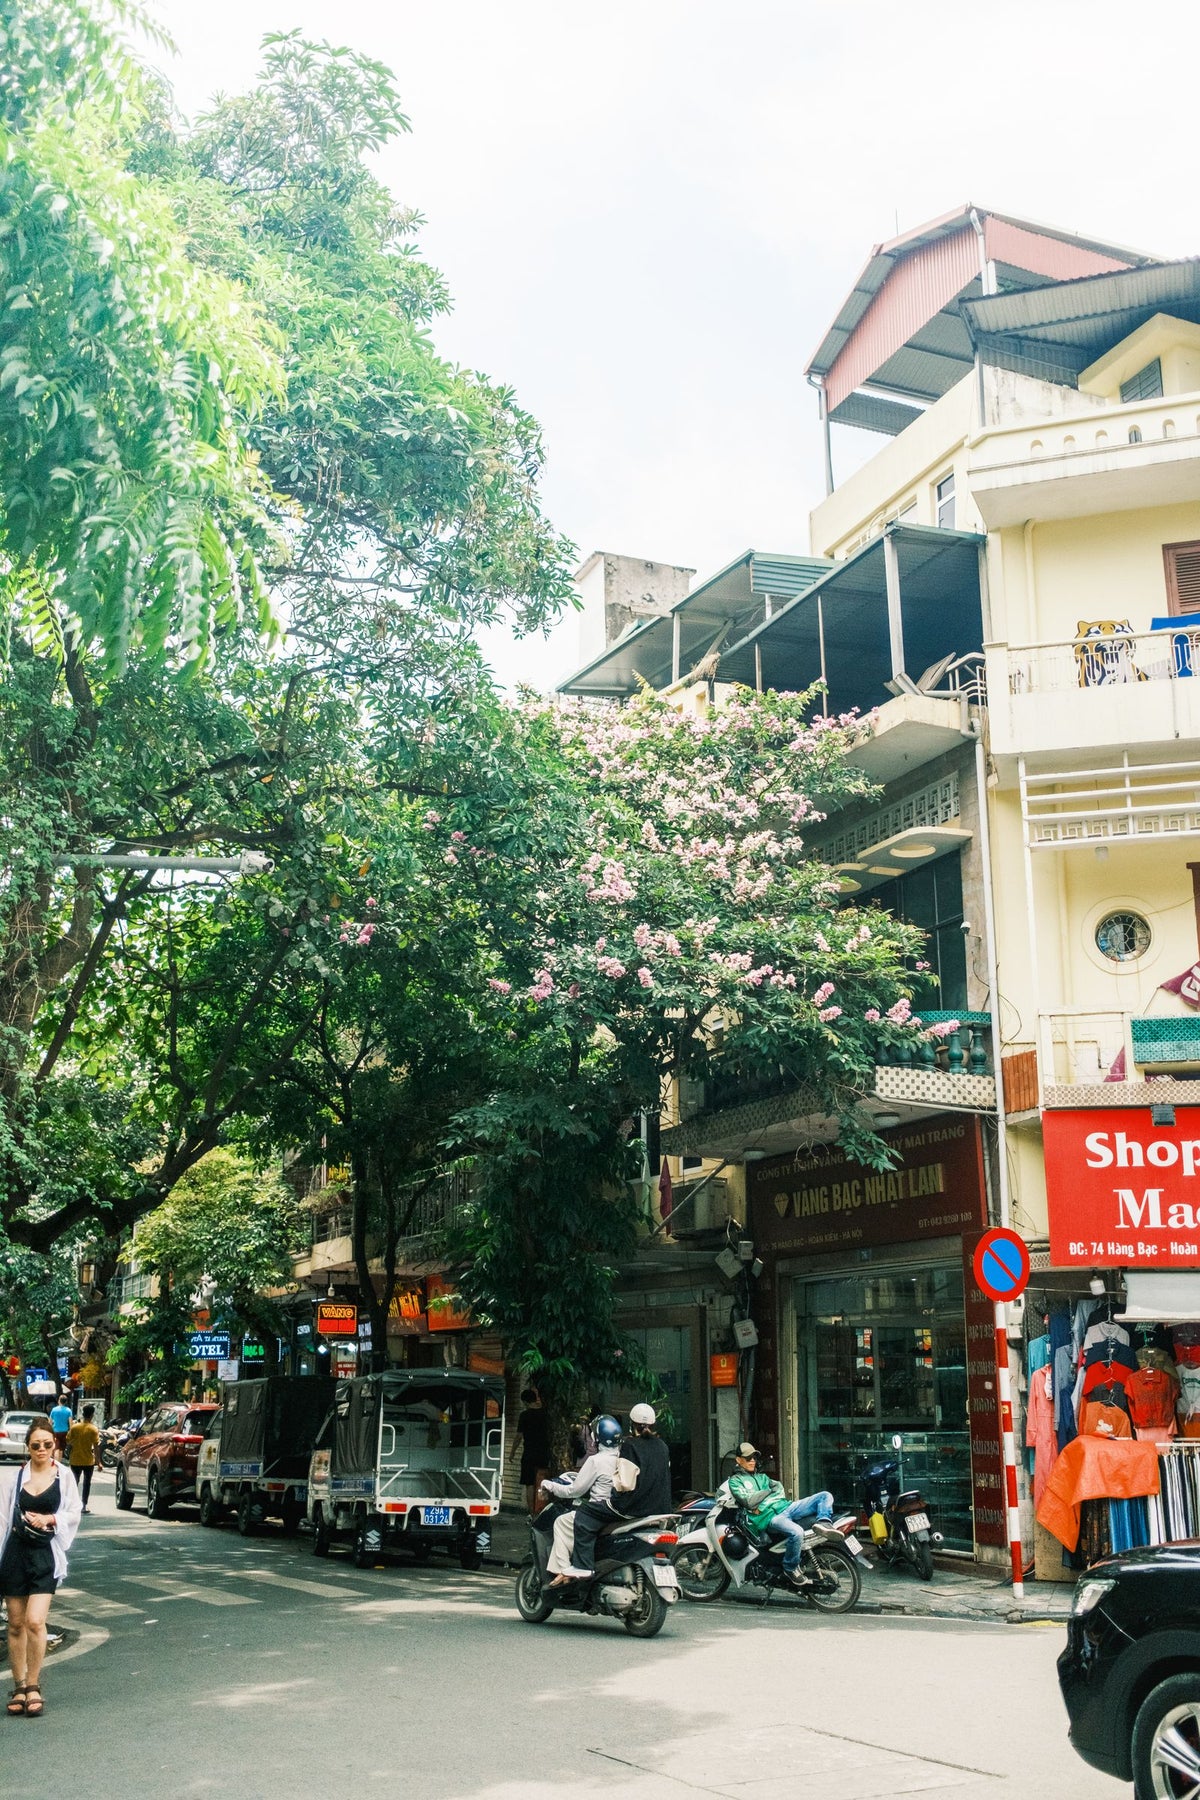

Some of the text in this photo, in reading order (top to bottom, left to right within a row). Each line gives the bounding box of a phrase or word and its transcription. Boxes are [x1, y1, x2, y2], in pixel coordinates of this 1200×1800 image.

[904, 1133, 926, 1150] MAI
[927, 1125, 966, 1145] TRANG
[781, 1164, 791, 1175] TY
[793, 1183, 830, 1218] VÀNG
[832, 1179, 862, 1216] BẠC
[908, 1163, 945, 1198] LAN
[1113, 1188, 1200, 1229] Ma
[1069, 1242, 1088, 1256] ĐC:
[1091, 1242, 1104, 1256] 74
[1107, 1242, 1135, 1258] Hàng
[1138, 1242, 1158, 1257] Bạc
[1170, 1241, 1198, 1255] Hoàn
[321, 1305, 354, 1318] VÀNG
[186, 1344, 225, 1356] OTEL
[430, 1506, 445, 1515] 29A
